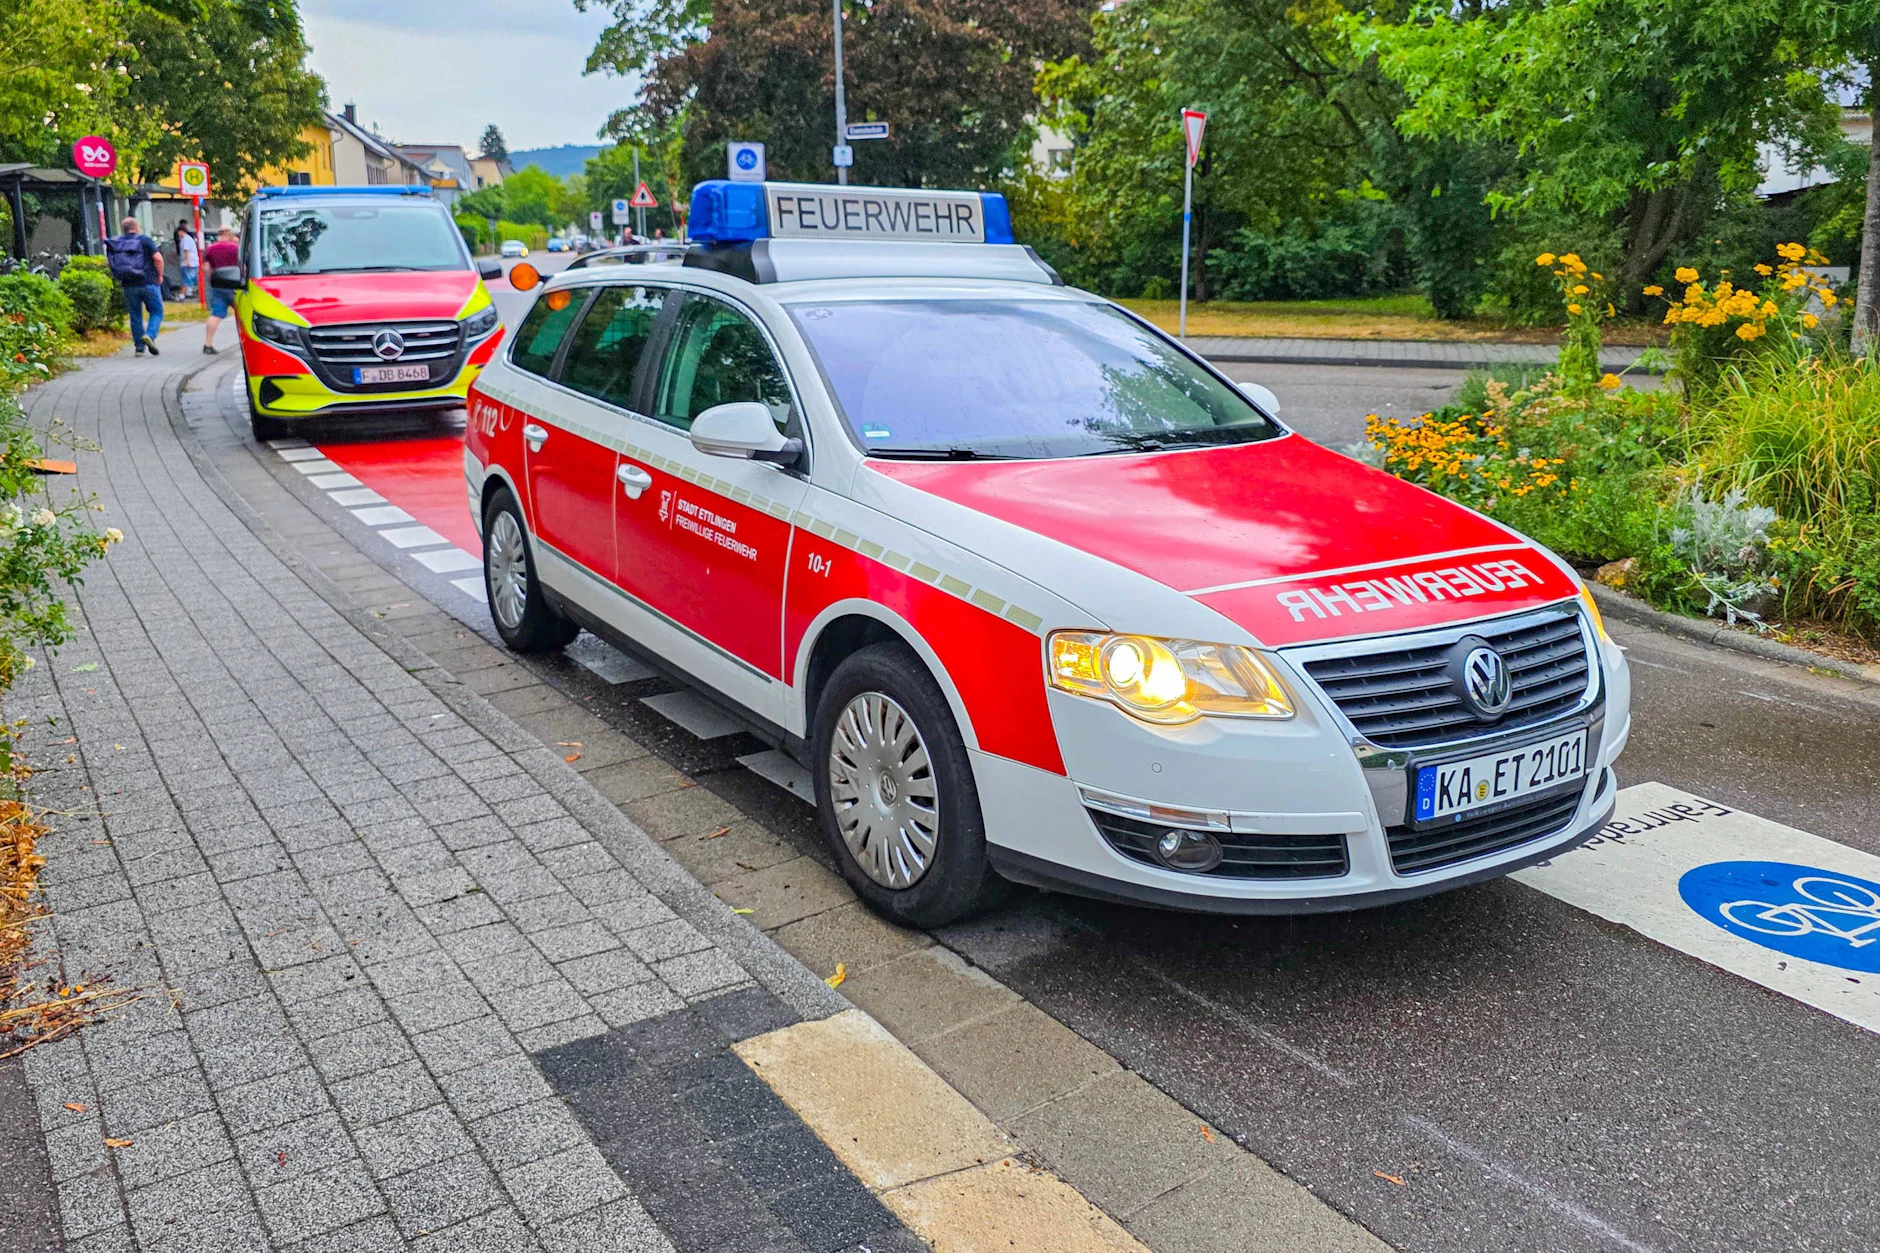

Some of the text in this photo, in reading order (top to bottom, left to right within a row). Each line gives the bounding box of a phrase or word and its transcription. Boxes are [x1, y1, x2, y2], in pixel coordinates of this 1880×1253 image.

[776, 196, 976, 235] FEUERWEHR
[362, 367, 428, 381] F DB 8468
[482, 404, 498, 438] 112
[677, 498, 737, 534] STADT ETTLINGEN
[675, 513, 758, 562] FREIWILLIGE FEUERWEHR
[807, 551, 833, 578] 10-1
[1465, 648, 1511, 713] VW
[1438, 736, 1582, 811] KA ET 2101
[1422, 798, 1431, 810] D
